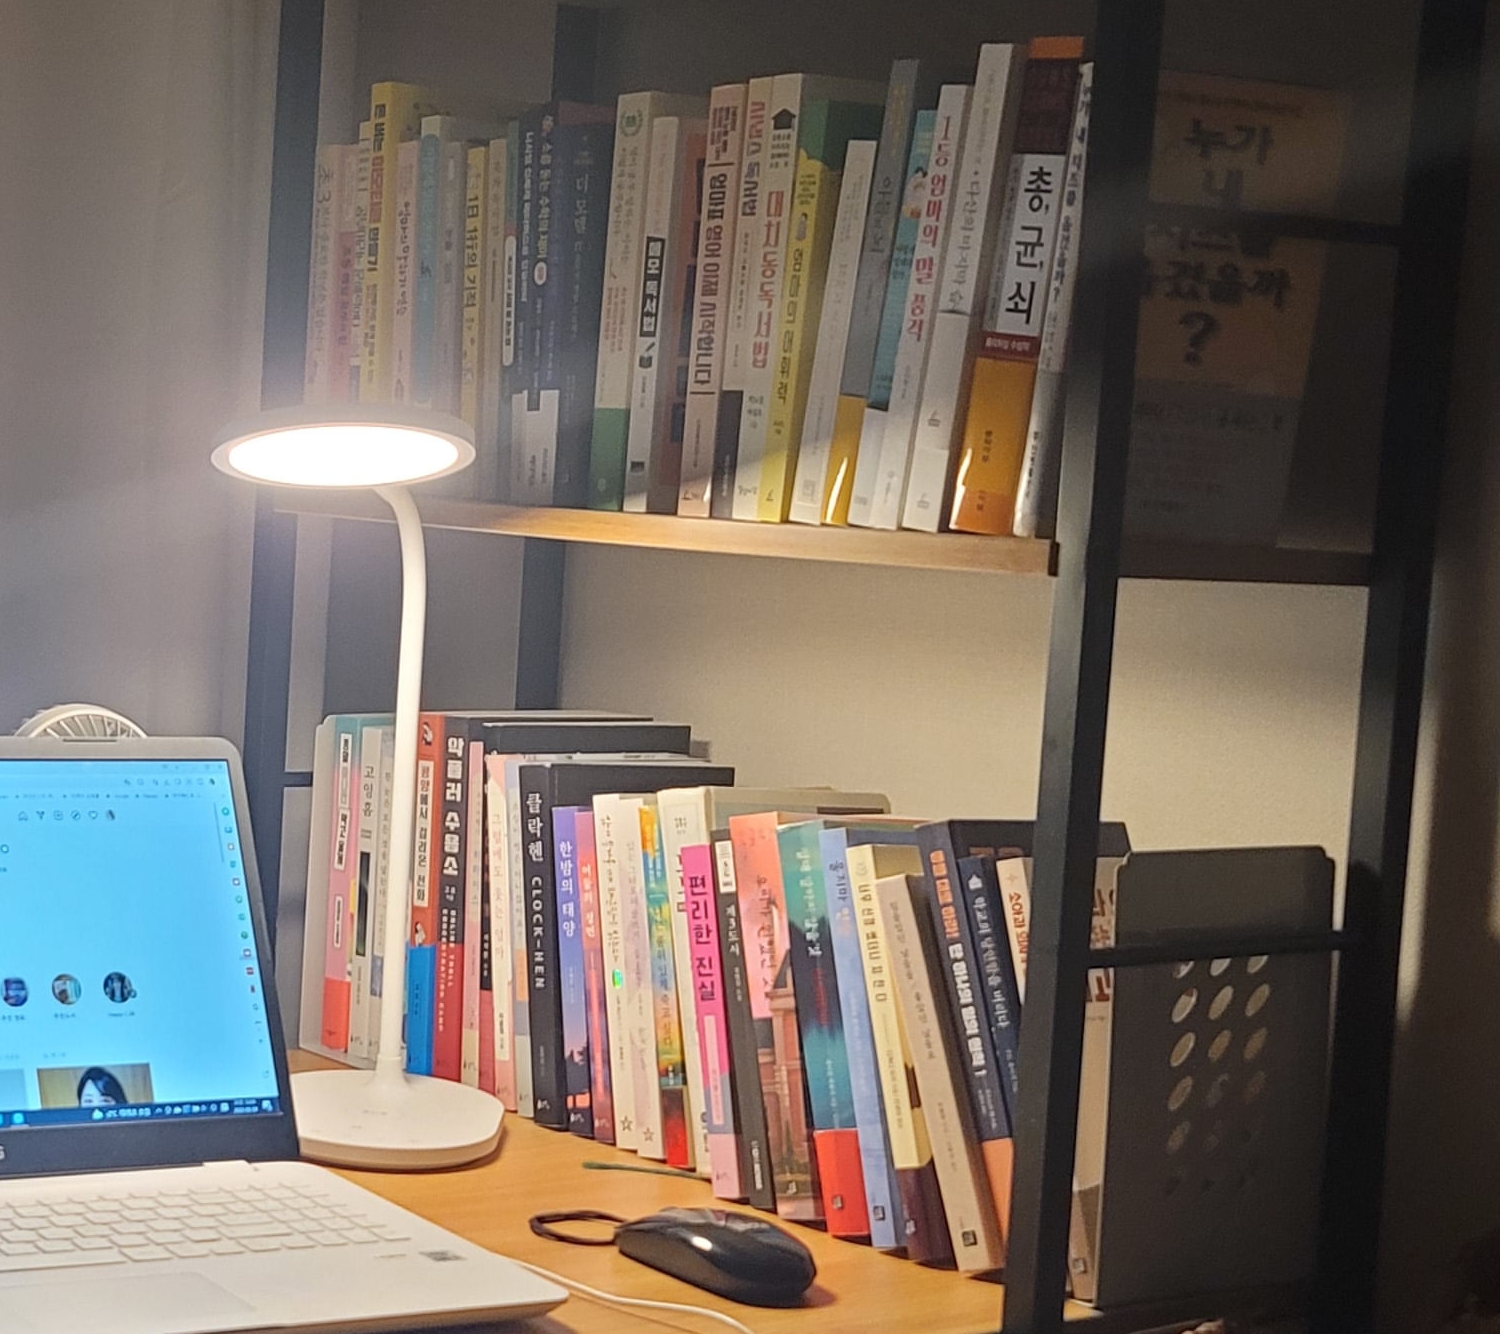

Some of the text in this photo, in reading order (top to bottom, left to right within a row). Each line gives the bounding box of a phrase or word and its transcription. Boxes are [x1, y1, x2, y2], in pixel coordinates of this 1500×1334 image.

[372, 121, 385, 153] 버는
[1184, 116, 1275, 166] 누가
[466, 194, 479, 219] 1日
[707, 172, 727, 221] 엄마표
[740, 160, 760, 217] 독서법
[365, 225, 380, 273] 만들기
[704, 224, 722, 258] 영어
[905, 114, 955, 343] 1등 엄마의 말 품격
[463, 274, 477, 308] 기적
[701, 262, 719, 297] 이제
[786, 247, 804, 324] 엄마의
[1004, 280, 1037, 325] 쇠
[641, 279, 658, 332] 독서법
[693, 301, 716, 385] 시작합니다
[362, 765, 375, 818] 고잉홈
[442, 736, 465, 877] 악플러 수용소
[415, 765, 432, 902] 평양에서 걸려온 전화
[526, 792, 547, 989] 클락헨 CLOCK-HEN
[559, 841, 577, 937] 한밤의 태양
[1008, 890, 1027, 928] 소아과
[688, 875, 717, 1002] 편리한 진실
[725, 903, 741, 957] 제3도시
[952, 960, 973, 1005] 하나의
[992, 989, 1010, 1028] 버리다
